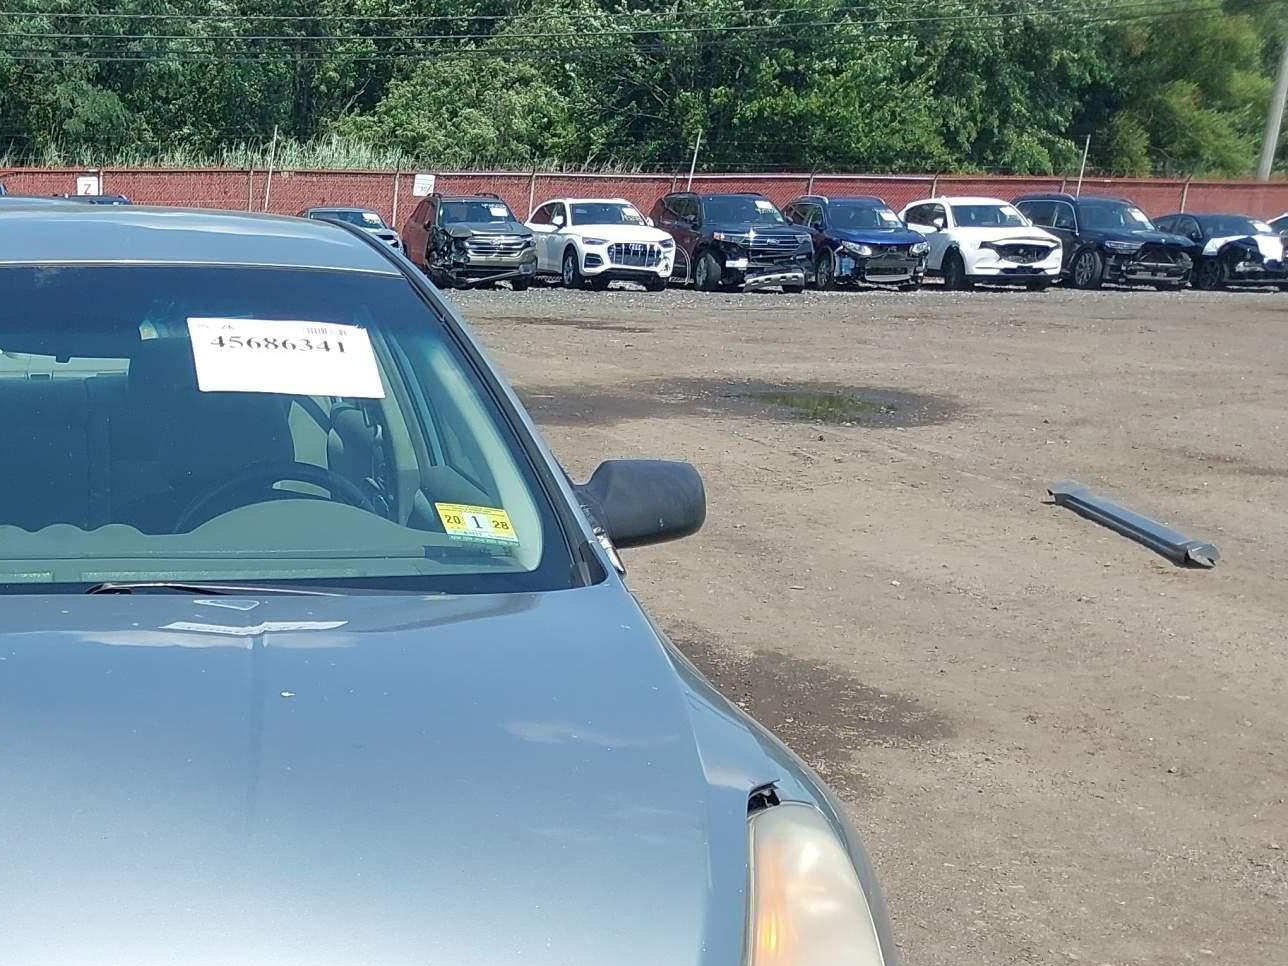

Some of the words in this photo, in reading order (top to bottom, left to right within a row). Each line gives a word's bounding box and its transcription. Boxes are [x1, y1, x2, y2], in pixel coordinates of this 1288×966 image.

[210, 335, 346, 353] 45686341
[445, 515, 461, 525] 20
[471, 516, 482, 529] 1
[492, 520, 509, 530] 28
